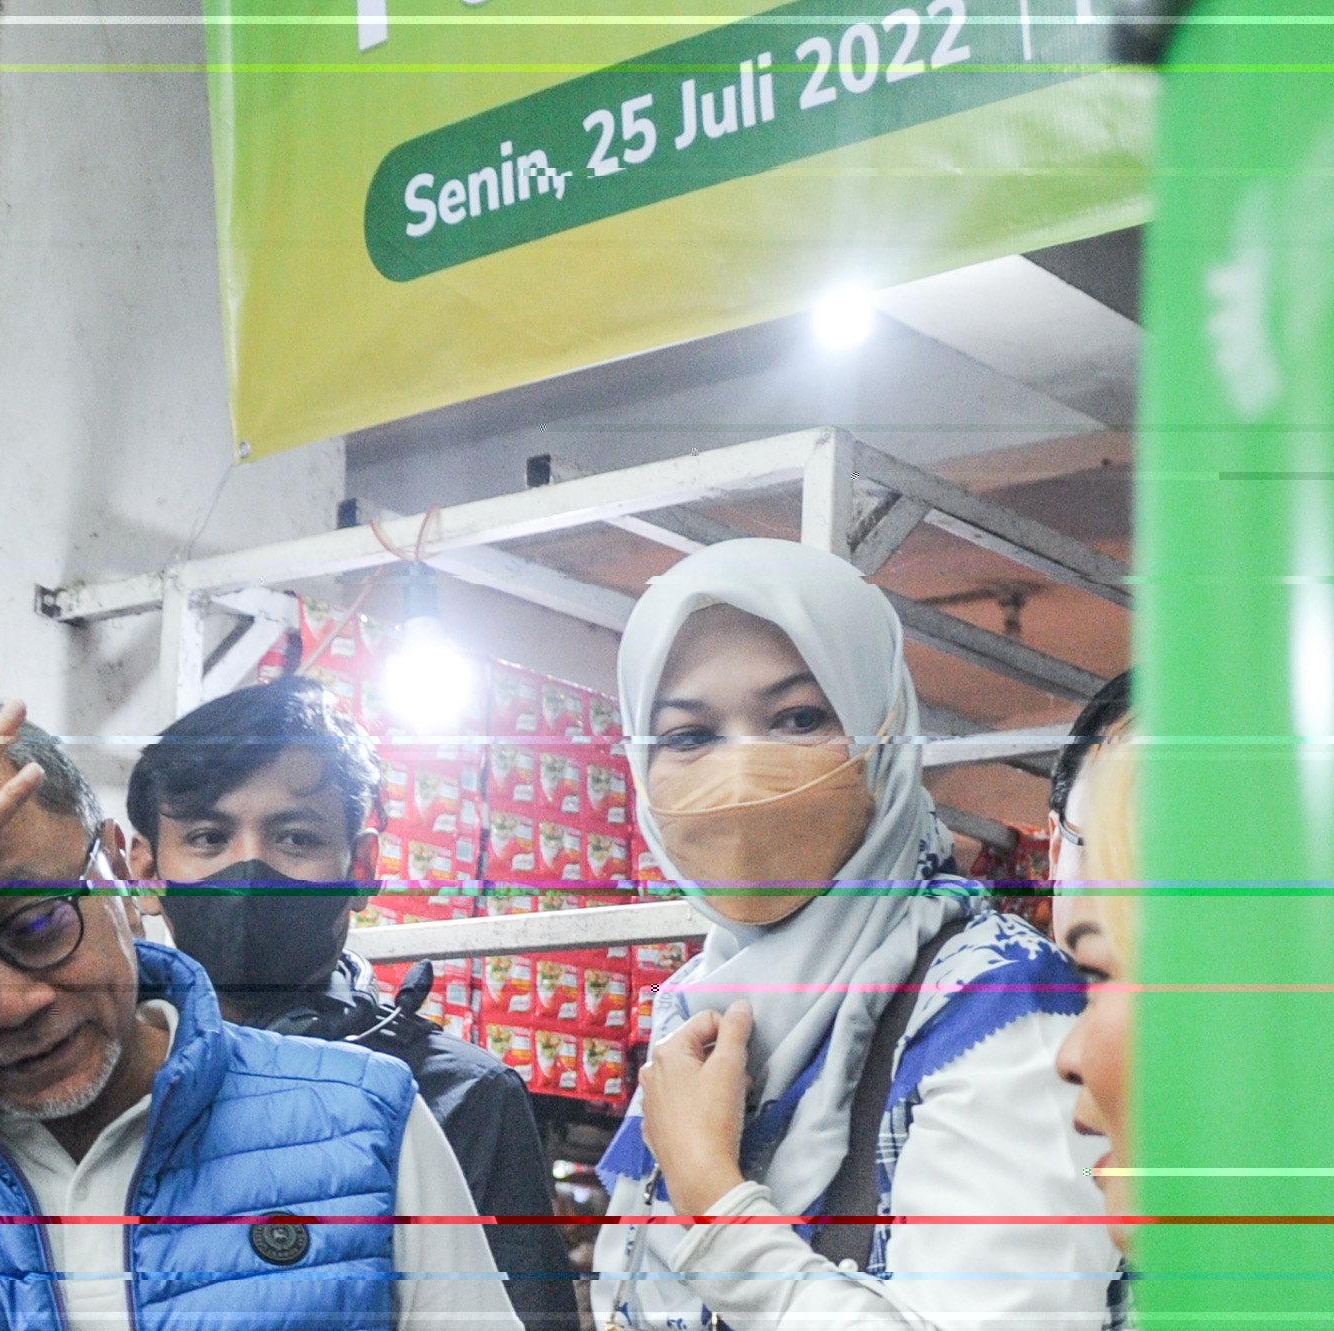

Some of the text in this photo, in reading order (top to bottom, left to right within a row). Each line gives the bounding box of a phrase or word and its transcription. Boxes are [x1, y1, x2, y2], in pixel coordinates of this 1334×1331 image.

[404, 0, 971, 238] Senin, 25 Juli 2022
